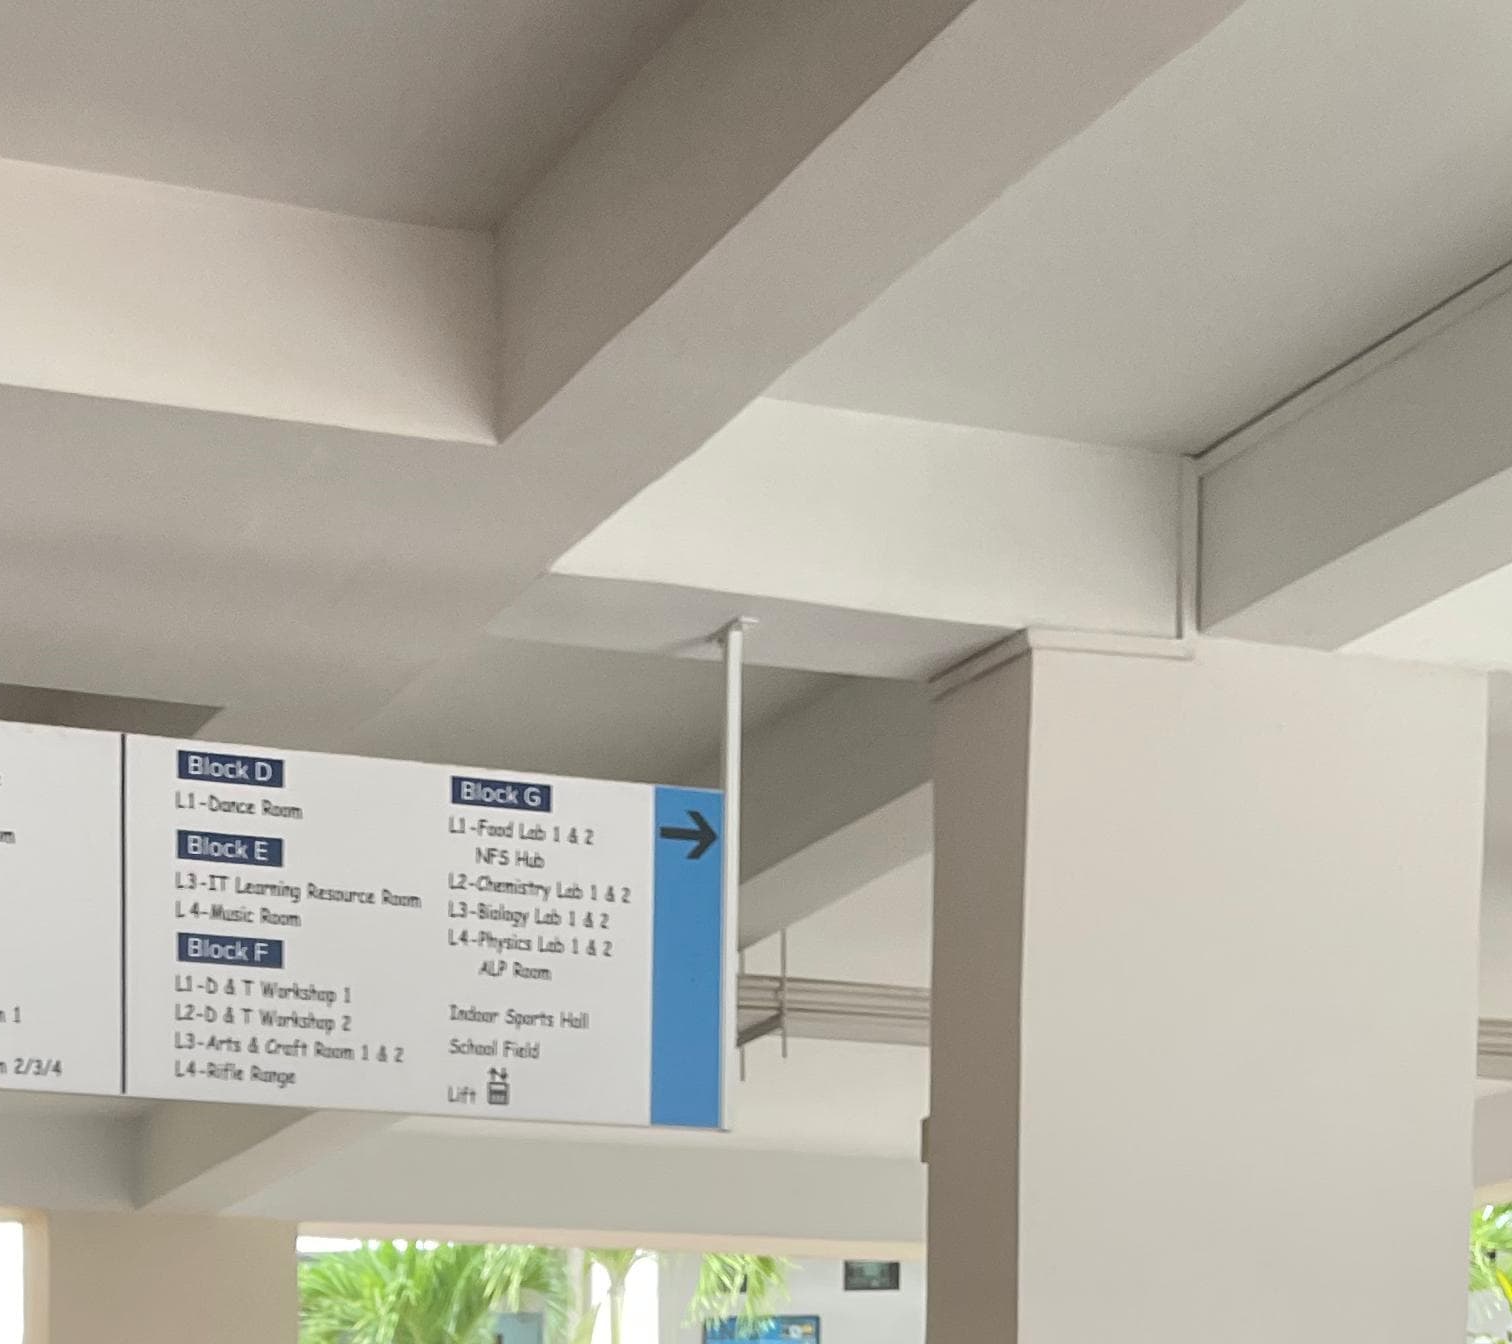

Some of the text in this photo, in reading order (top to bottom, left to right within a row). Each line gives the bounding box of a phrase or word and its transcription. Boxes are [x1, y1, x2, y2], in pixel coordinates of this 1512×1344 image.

[188, 755, 273, 782] Block D
[460, 781, 542, 807] Block G
[262, 799, 302, 819] Room
[519, 824, 546, 841] Lab
[552, 825, 561, 843] 1
[567, 827, 579, 845] &
[584, 828, 594, 846] 2
[188, 834, 268, 861] Block E
[476, 848, 544, 868] NFS Hub
[235, 877, 301, 903] Learning
[308, 883, 375, 904] Resource
[382, 889, 421, 907] Room
[557, 883, 583, 899] Lab
[590, 884, 598, 902] 1
[605, 885, 616, 903] &
[621, 886, 631, 904] 2
[260, 908, 301, 926] Room
[535, 909, 561, 925] Lab
[568, 910, 576, 928] 1
[583, 911, 594, 929] &
[599, 912, 610, 930] 2
[187, 936, 269, 962] Block F
[538, 937, 564, 953] Lab
[571, 937, 580, 955] 1
[586, 939, 597, 957] &
[602, 940, 613, 958] 2
[479, 960, 551, 980] ALP Room
[224, 978, 236, 996] &
[241, 979, 255, 996] T
[261, 982, 336, 1005] Workshop
[343, 986, 351, 1004] 1
[12, 1006, 21, 1024] 1
[222, 1006, 235, 1025] &
[240, 1007, 254, 1024] T
[259, 1010, 335, 1034] Workshop
[341, 1015, 352, 1032] 2
[450, 1004, 589, 1029] Indoor Sports Hall
[247, 1036, 260, 1054] &
[265, 1039, 307, 1056] Craft
[315, 1041, 354, 1060] Room
[361, 1044, 369, 1062] 1
[375, 1045, 388, 1063] &
[394, 1046, 404, 1064] 2
[449, 1039, 539, 1059] School Field
[14, 1058, 62, 1076] 2/3/4
[250, 1065, 295, 1088] Range
[448, 1087, 476, 1103] Lift
